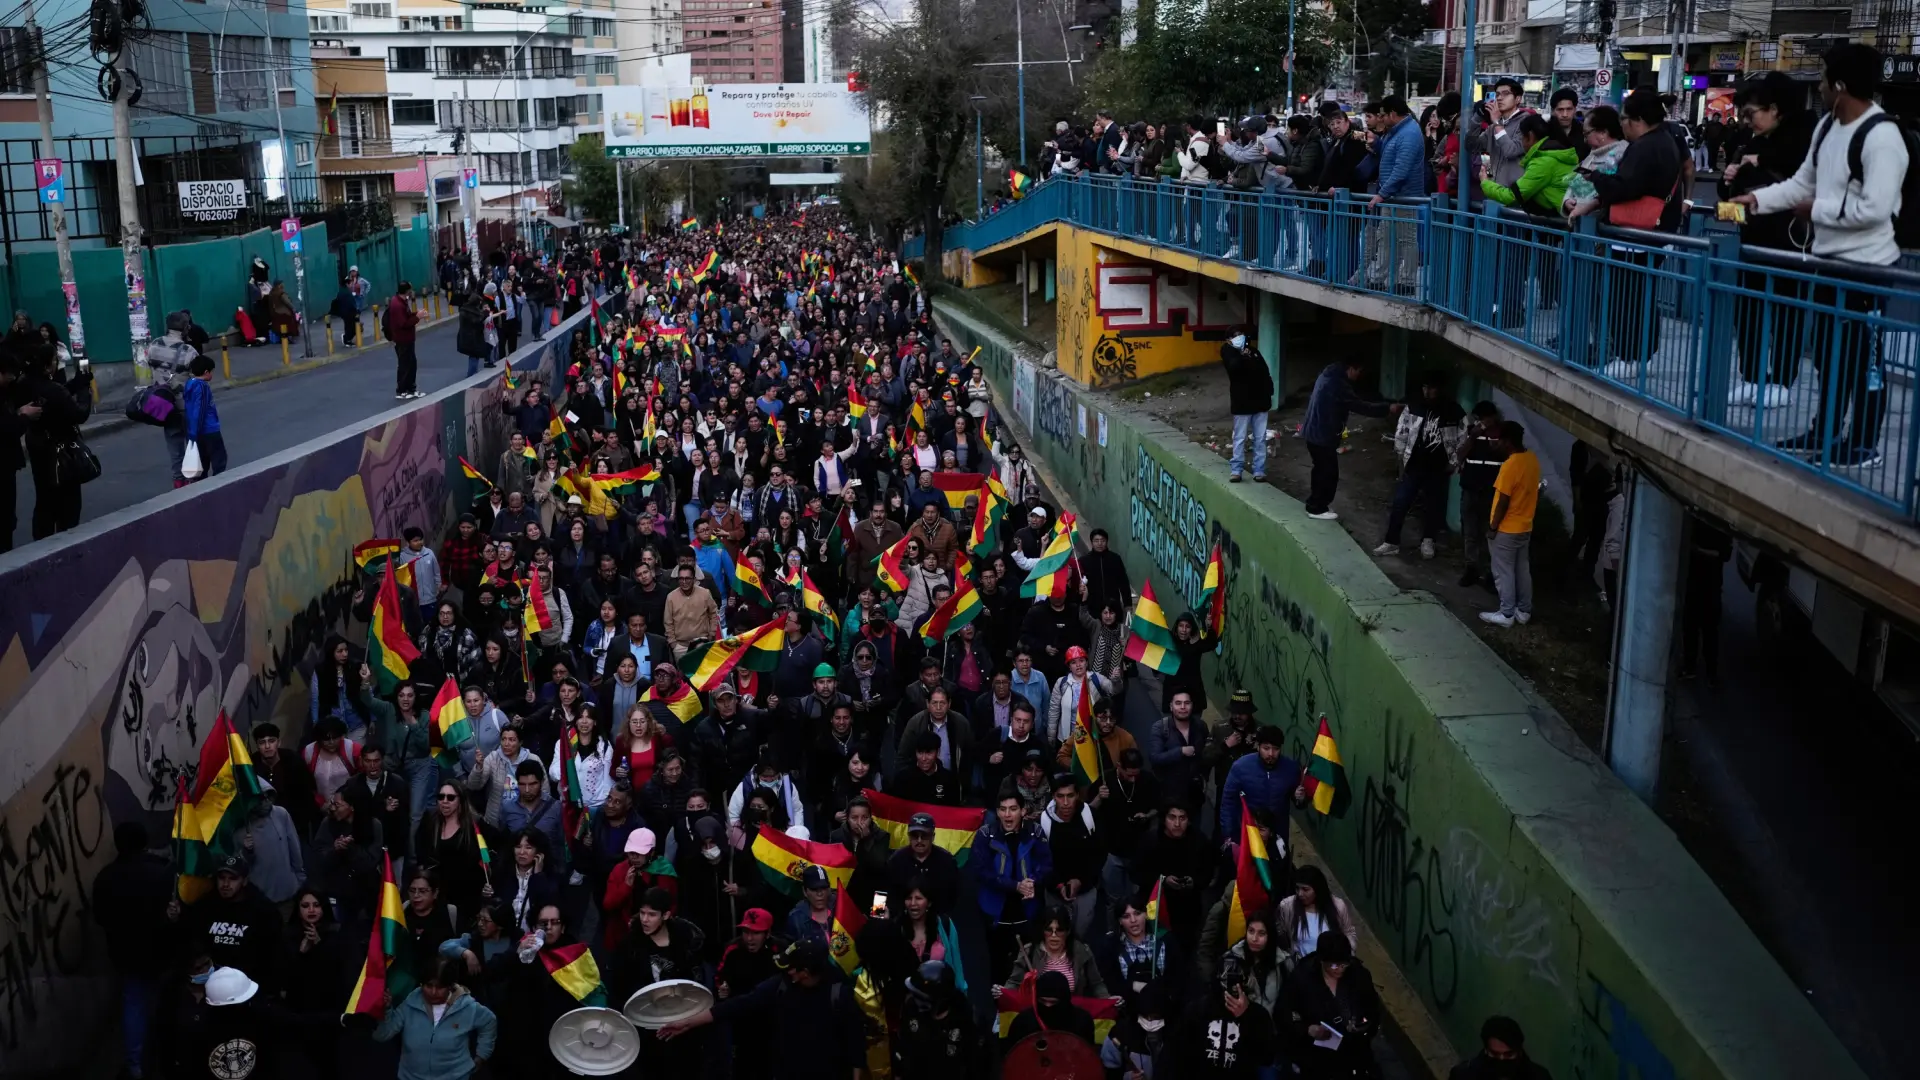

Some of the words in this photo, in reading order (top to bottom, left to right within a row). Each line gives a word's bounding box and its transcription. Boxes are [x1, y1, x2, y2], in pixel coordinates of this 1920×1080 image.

[721, 91, 753, 100] Repara
[762, 92, 795, 100] protege
[786, 111, 811, 119] Repair
[625, 147, 654, 156] BARRIO
[654, 146, 703, 155] UNIVERSIDAD
[703, 145, 734, 155] CANCHA
[734, 145, 763, 154] ZAPATA
[777, 144, 806, 153] BARRIO
[806, 144, 849, 152] SOPOCACHI
[189, 182, 234, 196] ESPACIO
[181, 194, 244, 209] DISPONIBLE
[193, 209, 238, 222] 70626057
[214, 935, 235, 945] 8:22
